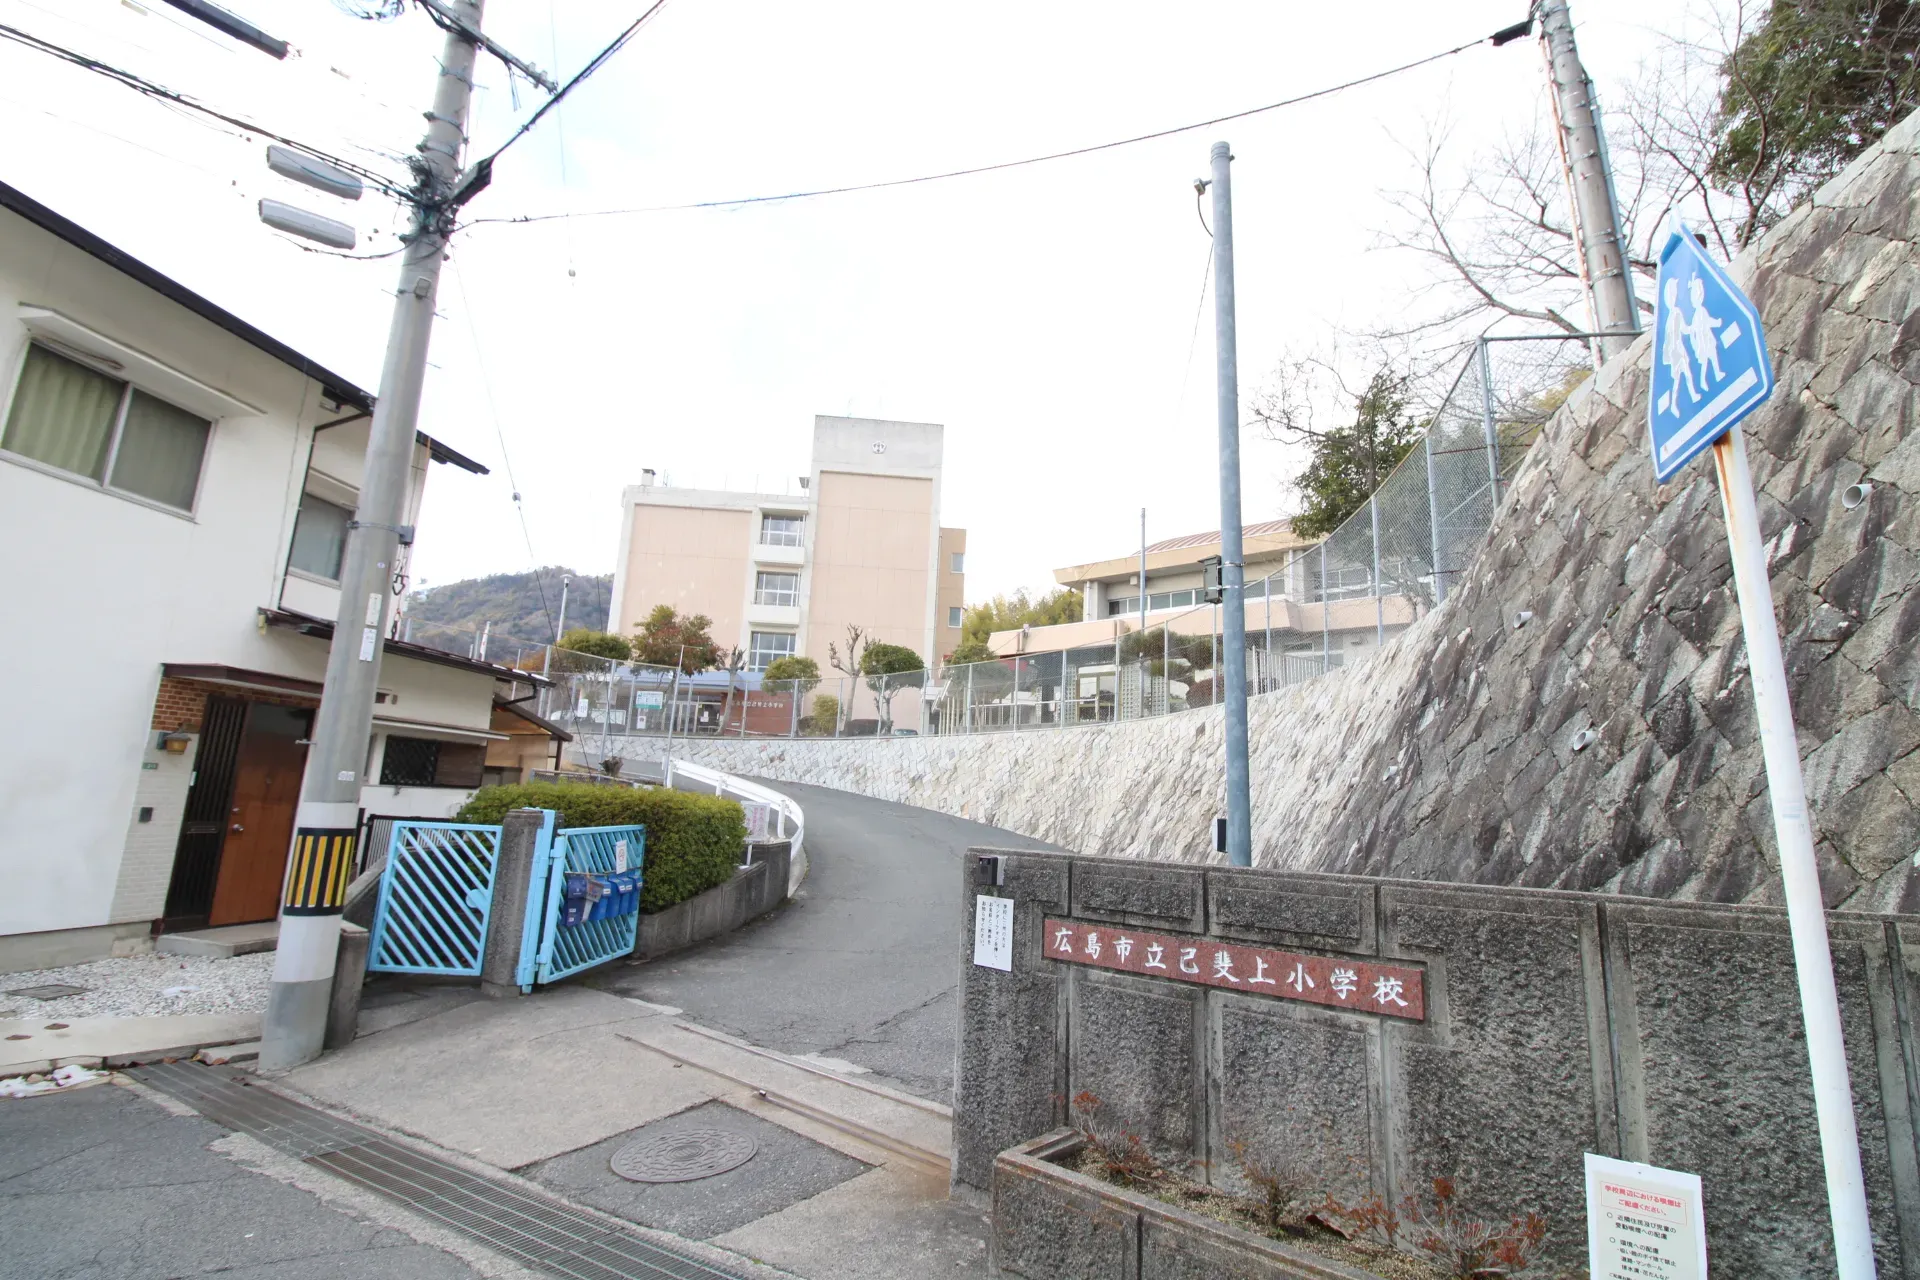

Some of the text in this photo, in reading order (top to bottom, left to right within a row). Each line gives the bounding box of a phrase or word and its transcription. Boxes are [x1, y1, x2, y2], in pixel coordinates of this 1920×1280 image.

[1053, 927, 1409, 1007] 広島市立己斐上小学校
